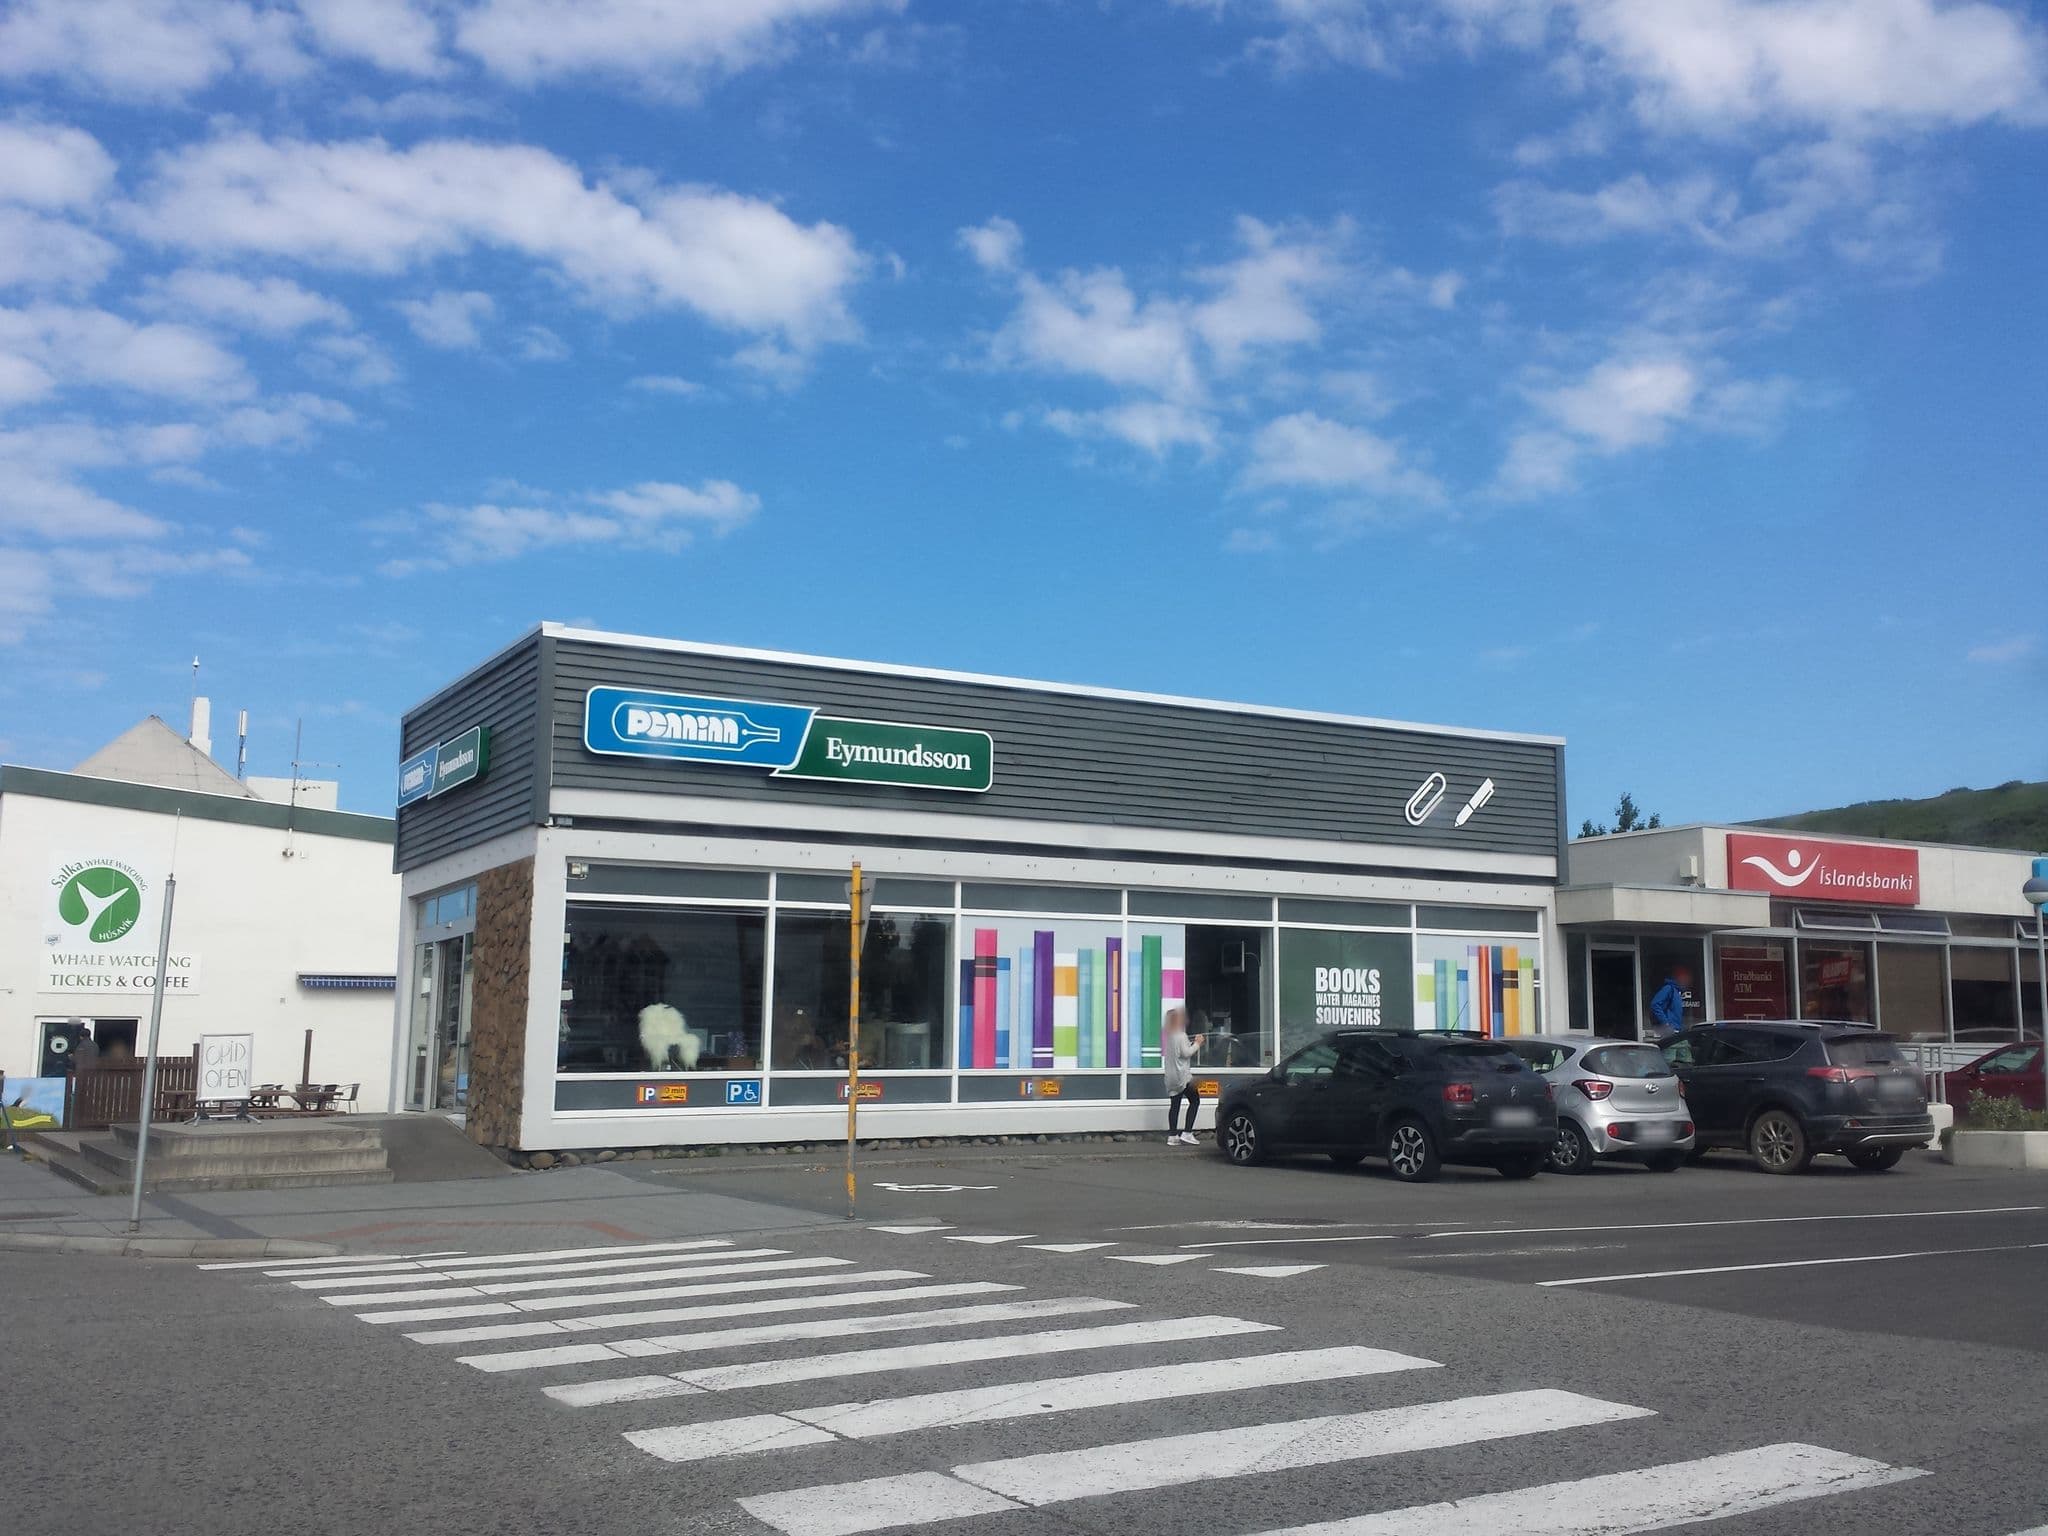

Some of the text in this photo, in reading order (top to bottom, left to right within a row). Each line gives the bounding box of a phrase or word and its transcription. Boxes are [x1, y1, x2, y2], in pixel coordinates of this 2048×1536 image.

[826, 737, 972, 772] Eymundsson
[51, 858, 149, 892] Salka WHALE WATCHING
[1819, 865, 1914, 891] Íslandsbanki
[98, 918, 134, 941] HÚSAVÍK
[52, 953, 191, 969] WHALE WATCHNG
[50, 974, 189, 989] TICKETS & COFEE
[1315, 967, 1381, 994] BOOKS
[1734, 983, 1753, 993] ATM
[1315, 993, 1381, 1007] WATER MAGAZINES
[1315, 1007, 1381, 1026] SOUVENIRS
[205, 1068, 248, 1089] OPEN
[645, 1087, 656, 1101] P
[671, 1086, 686, 1094] min
[730, 1084, 743, 1101] P
